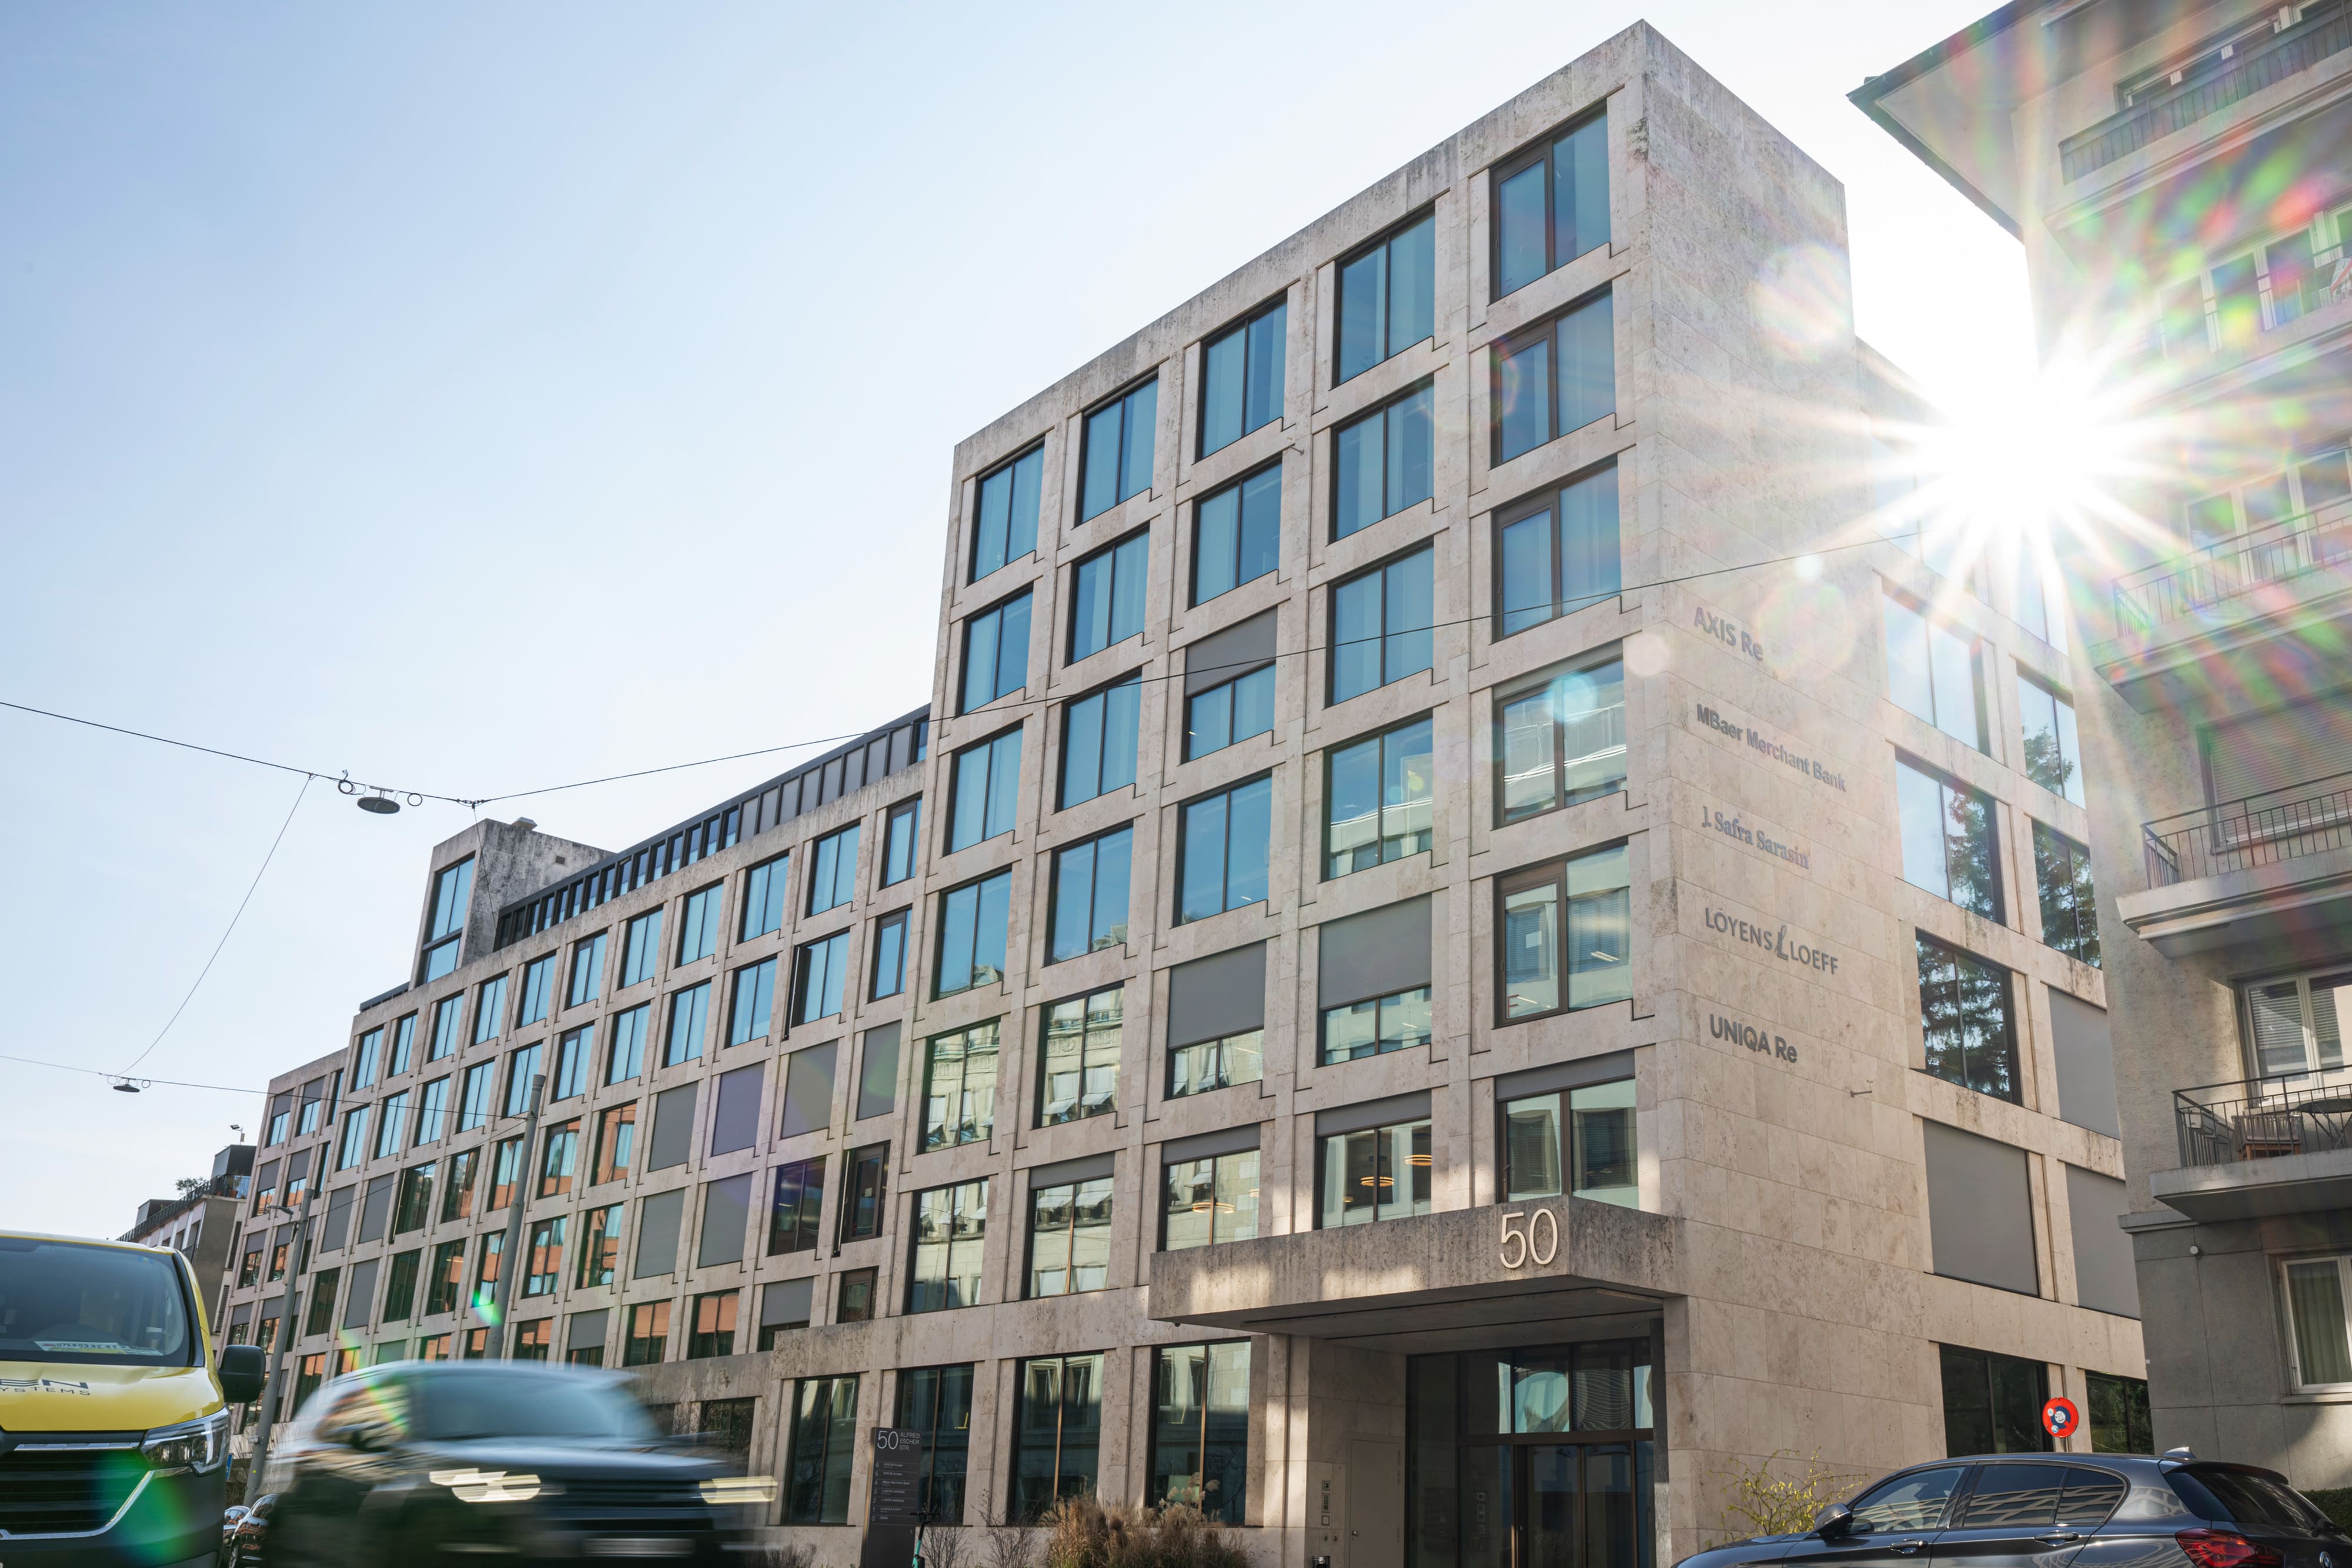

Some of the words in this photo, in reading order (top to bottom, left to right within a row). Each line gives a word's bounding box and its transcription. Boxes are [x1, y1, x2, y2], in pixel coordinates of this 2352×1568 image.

[1694, 606, 1736, 646] AXIS
[1741, 631, 1763, 661] Re
[1697, 704, 1743, 741] MBaer
[1747, 728, 1810, 775] Merchant
[1813, 761, 1846, 793] Bank
[1715, 811, 1753, 845] Safra
[1757, 830, 1810, 870] Sarasin
[1705, 907, 1772, 951] LOYENS
[1790, 941, 1838, 975] LOEFF
[1710, 1014, 1771, 1055] UNIQA
[1775, 1036, 1798, 1064] Re
[1500, 1208, 1558, 1269] 50
[877, 1430, 898, 1449] 50
